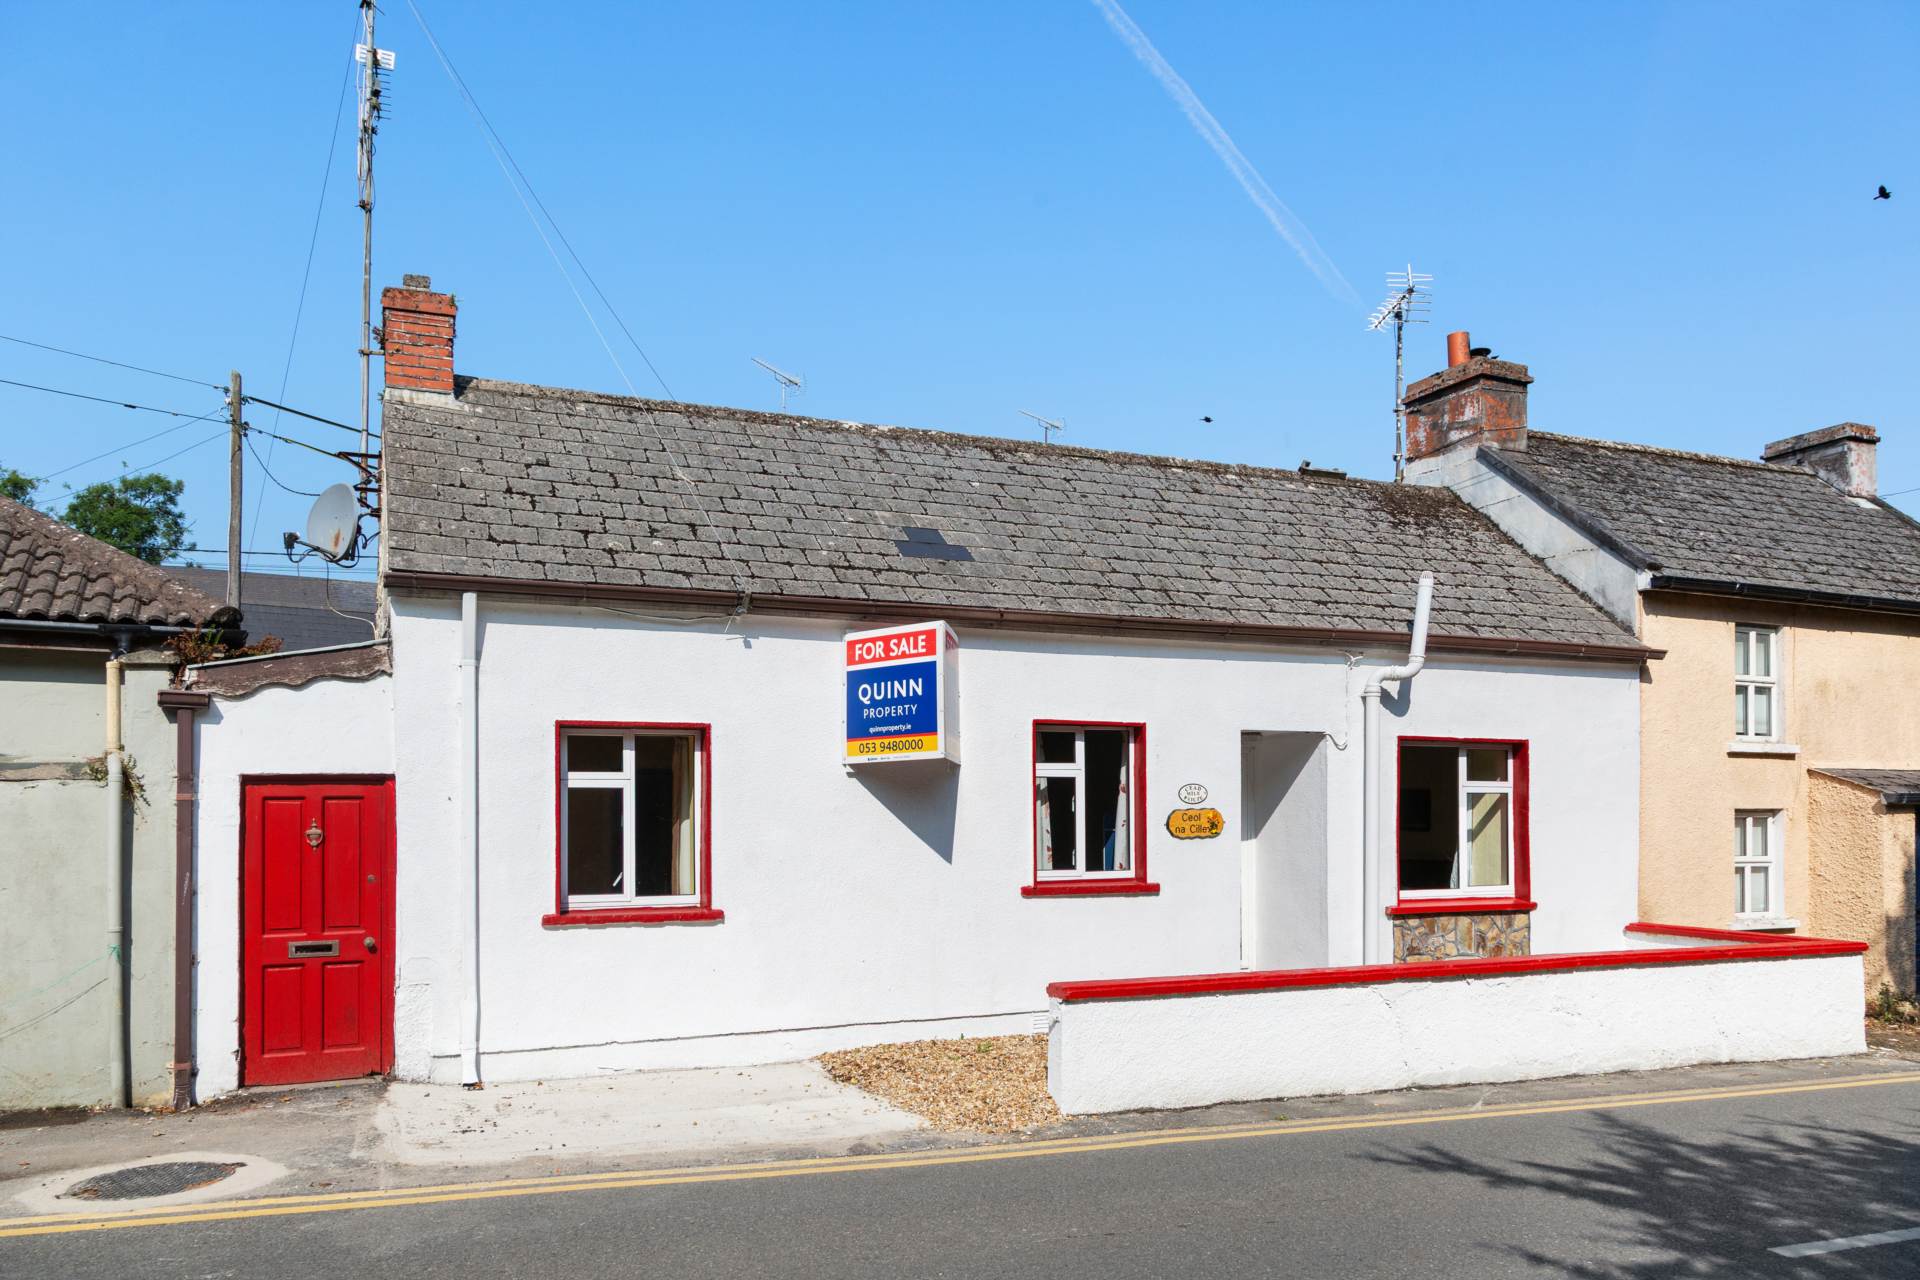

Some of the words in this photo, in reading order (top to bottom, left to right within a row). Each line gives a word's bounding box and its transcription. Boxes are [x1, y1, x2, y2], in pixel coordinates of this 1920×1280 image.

[855, 641, 885, 661] FOR
[889, 635, 926, 657] SALE
[858, 678, 923, 704] QUINN
[863, 704, 918, 719] PROPERTY
[868, 723, 912, 734] quinnproperty.ie
[858, 743, 877, 754] 053
[879, 738, 924, 752] 9480000
[1181, 812, 1201, 821] Ceol
